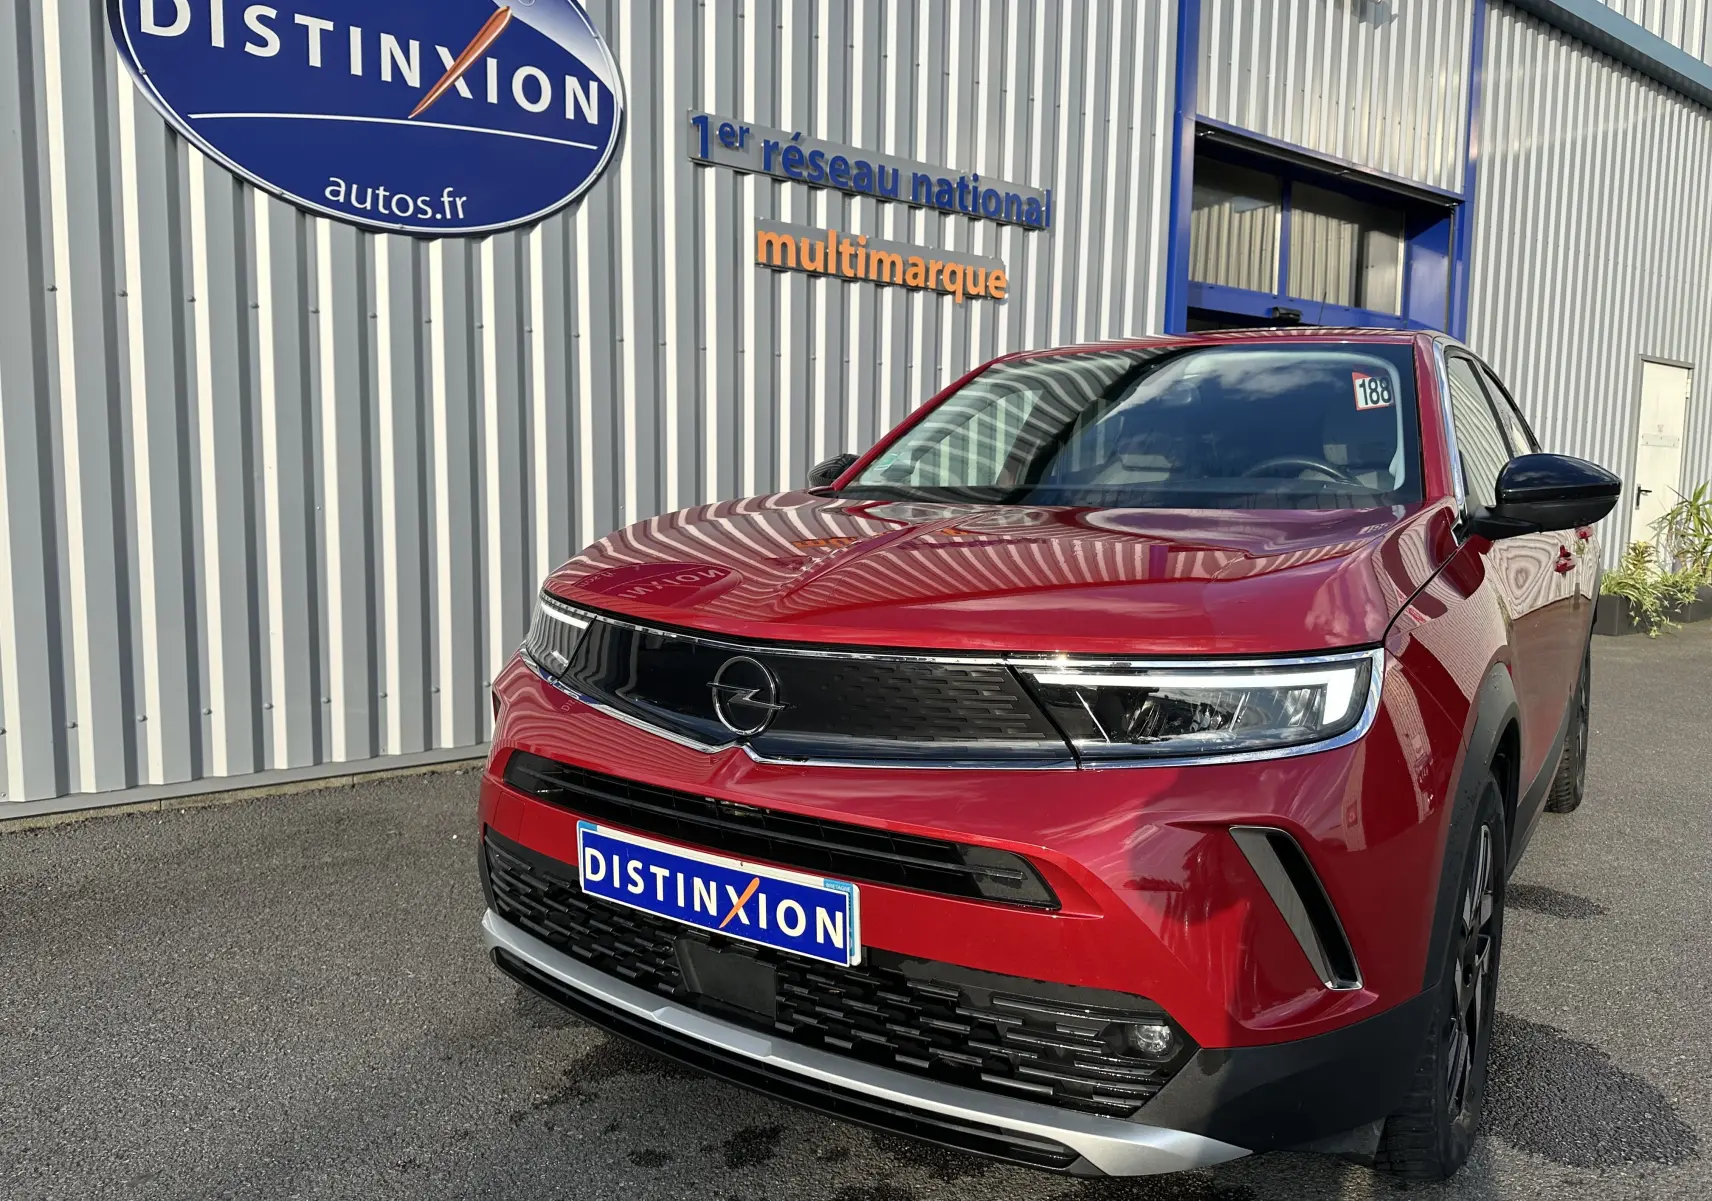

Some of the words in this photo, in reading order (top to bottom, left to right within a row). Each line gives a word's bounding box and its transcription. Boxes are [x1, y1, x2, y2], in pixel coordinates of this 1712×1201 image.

[140, 0, 598, 125] DISTINXION
[324, 177, 468, 220] autos.fr
[691, 115, 750, 159] 1er
[763, 132, 899, 198] réseau
[911, 173, 1051, 227] national
[757, 229, 1008, 303] multimarque
[1359, 377, 1392, 405] 188
[585, 846, 844, 949] DISTINXION
